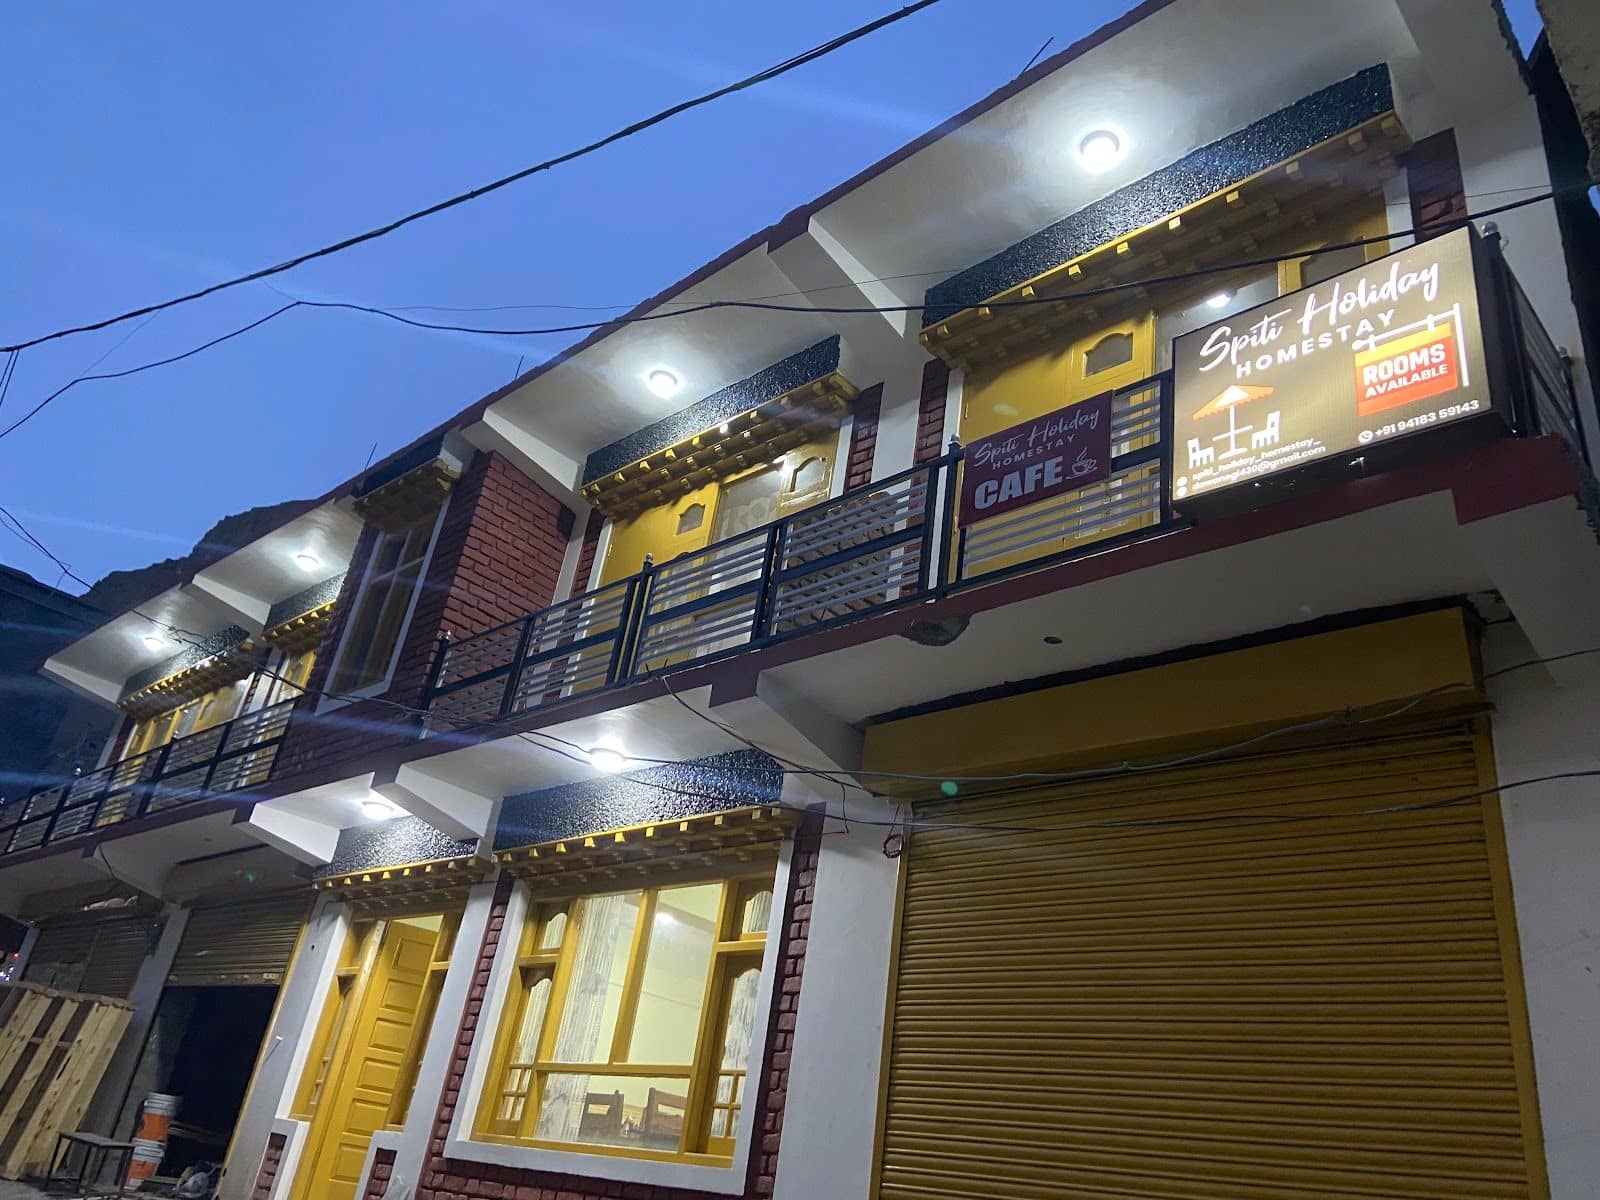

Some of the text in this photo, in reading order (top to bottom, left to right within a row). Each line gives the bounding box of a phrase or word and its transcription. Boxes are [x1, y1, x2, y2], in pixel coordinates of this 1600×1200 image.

[1199, 261, 1440, 372] Spiti Holiday
[1236, 309, 1396, 379] HOMESTAY
[1363, 344, 1446, 386] ROOMS
[1366, 364, 1449, 399] AVAILABLE
[973, 409, 1100, 467] Spiti Holiday
[1375, 400, 1480, 437] +91 94183 59143
[992, 434, 1076, 470] HOMESTAY
[974, 455, 1063, 510] CAFE
